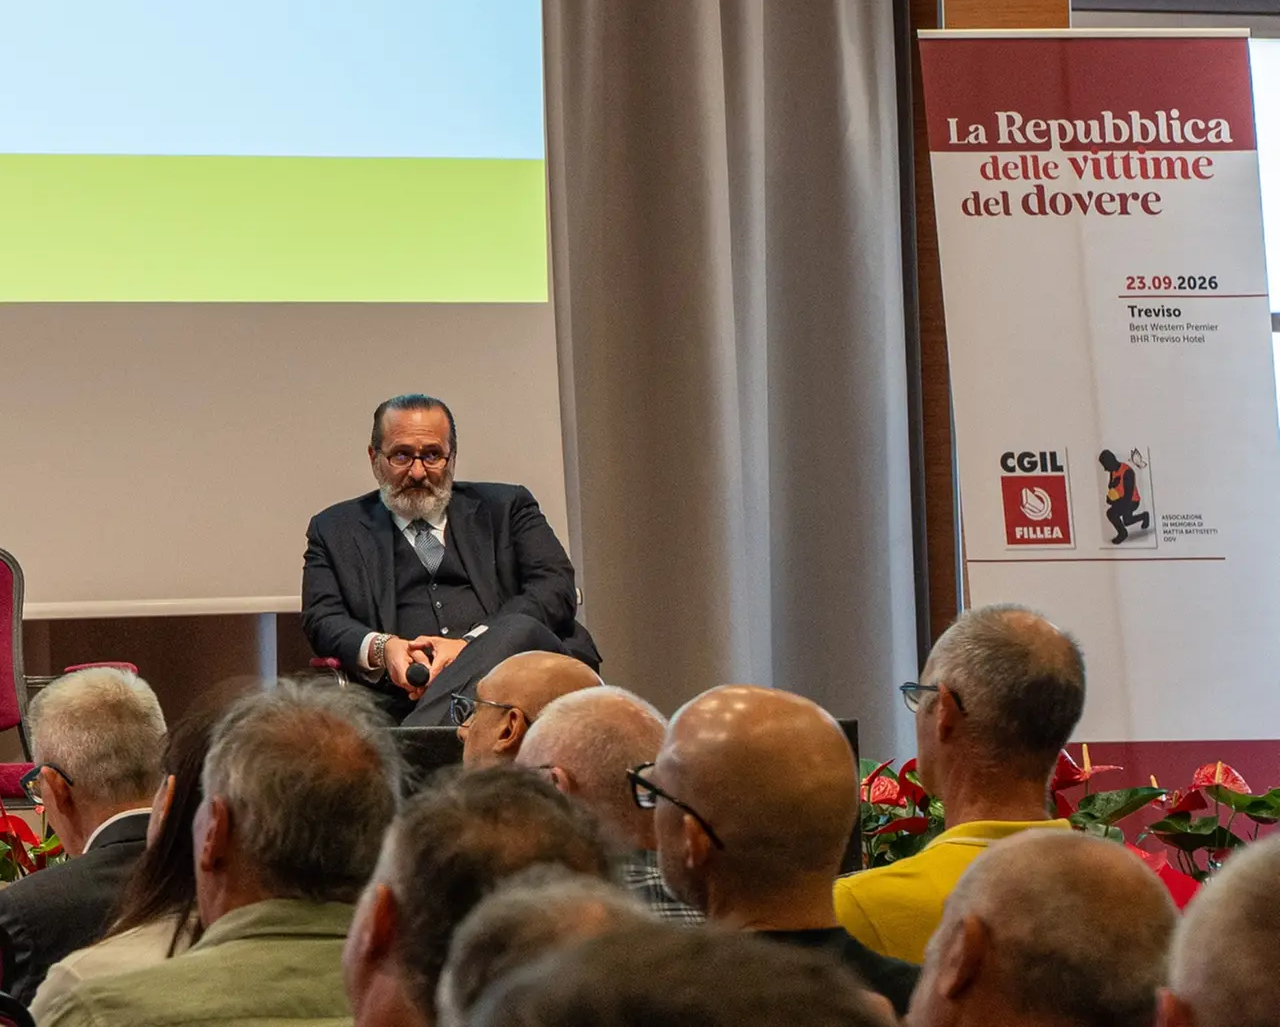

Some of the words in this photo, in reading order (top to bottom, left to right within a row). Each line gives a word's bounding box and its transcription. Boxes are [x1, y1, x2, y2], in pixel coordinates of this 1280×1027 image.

[947, 118, 988, 145] La
[994, 108, 1233, 152] Repubblica
[980, 154, 1061, 181] delle
[1068, 146, 1215, 181] vittime
[961, 190, 1013, 217] del
[1020, 184, 1164, 217] dovere
[1126, 275, 1218, 290] 23.09.2026
[1127, 304, 1182, 318] Treviso
[1129, 323, 1148, 332] Best
[1150, 323, 1184, 332] Western
[1186, 323, 1218, 332] Premier
[1130, 335, 1149, 343] BHR
[1151, 335, 1181, 343] Treviso
[1183, 335, 1205, 343] Hotel
[1000, 451, 1064, 473] CGIL
[1015, 526, 1063, 540] FILLEA
